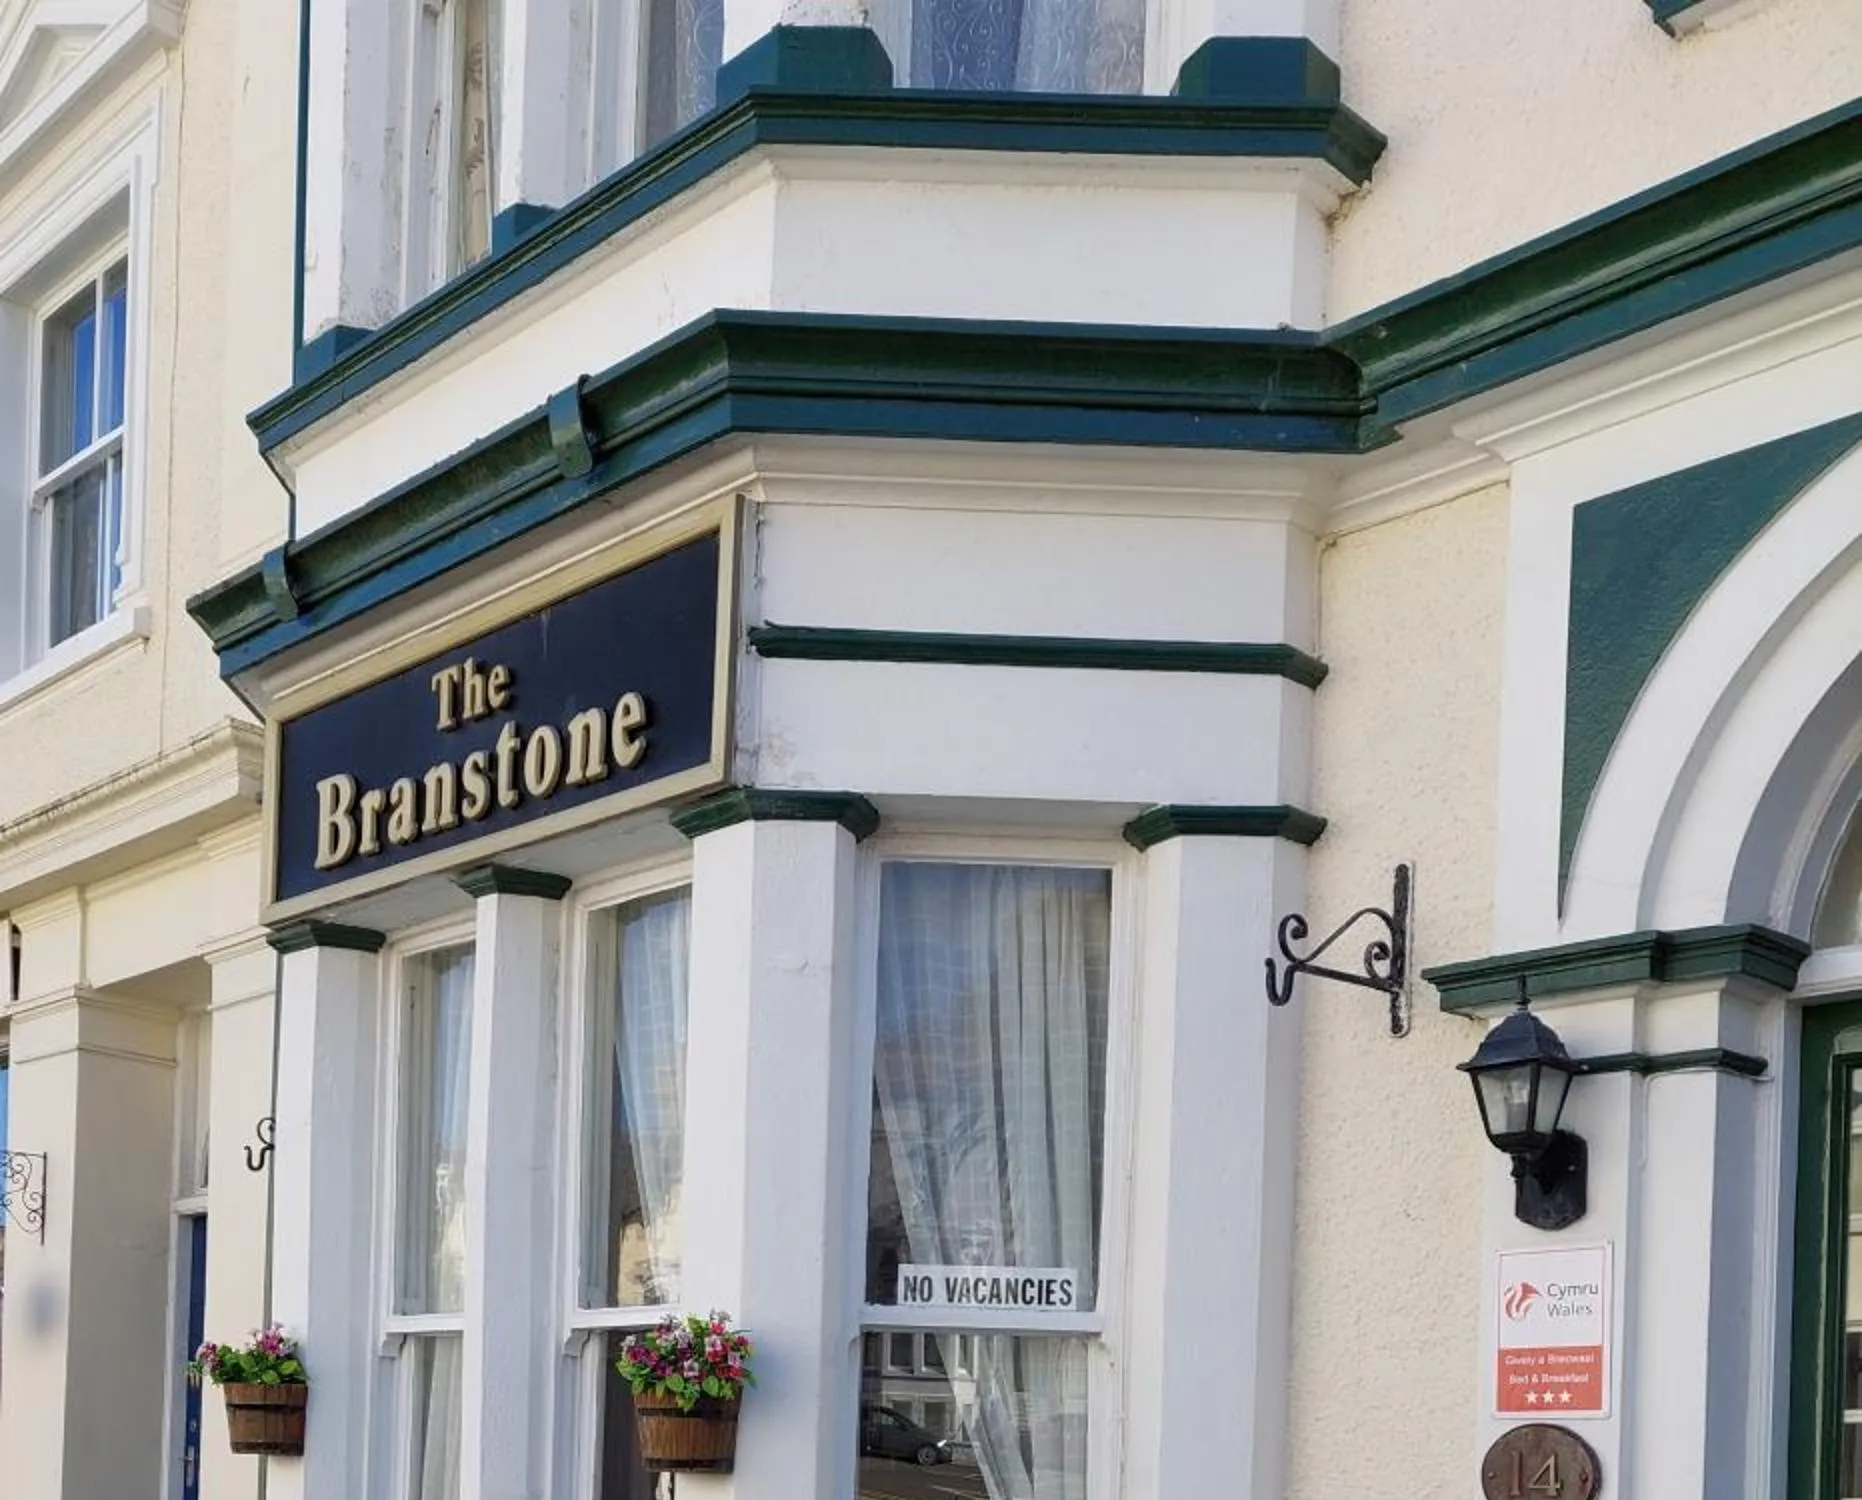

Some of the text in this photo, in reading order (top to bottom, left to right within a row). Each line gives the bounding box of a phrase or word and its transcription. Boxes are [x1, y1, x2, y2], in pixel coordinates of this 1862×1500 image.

[432, 656, 512, 732] The
[315, 692, 647, 870] Branstone
[903, 1275, 1072, 1306] NO VACANCIES
[1547, 1283, 1599, 1301] Cymru
[1547, 1302, 1593, 1317] Wales
[1509, 1449, 1561, 1498] 14
